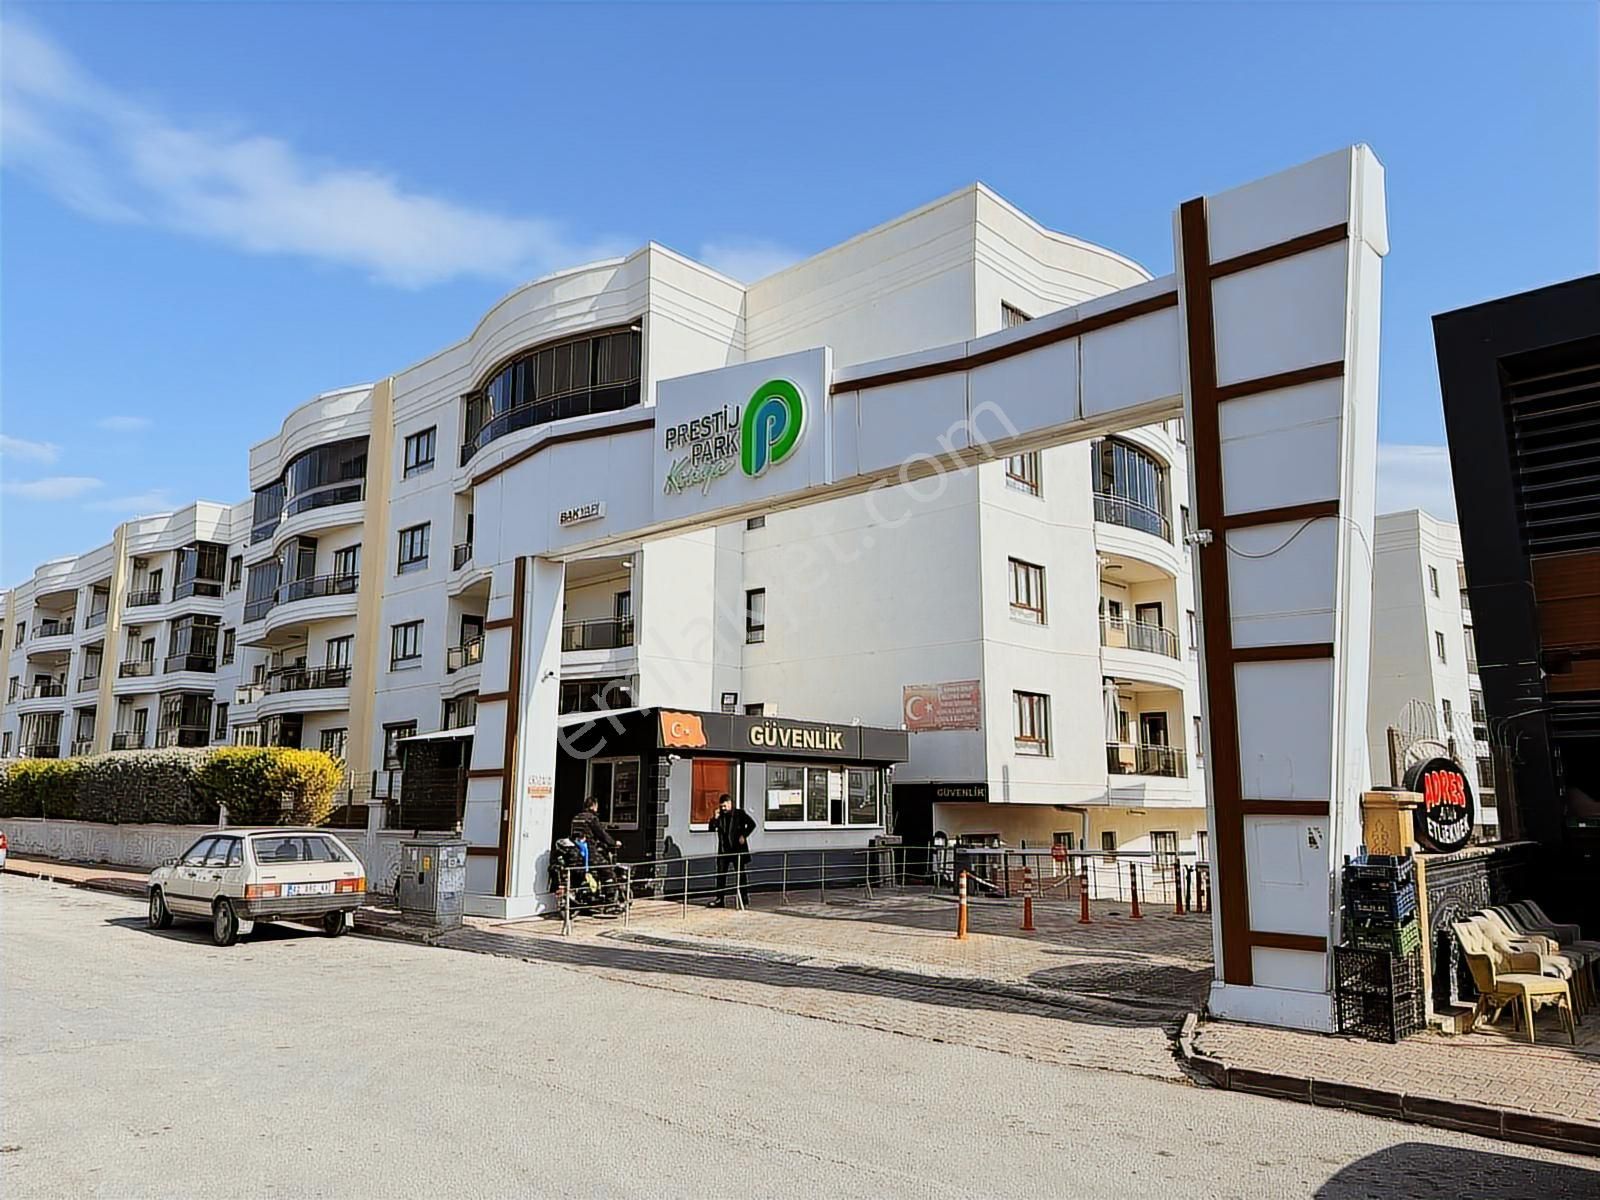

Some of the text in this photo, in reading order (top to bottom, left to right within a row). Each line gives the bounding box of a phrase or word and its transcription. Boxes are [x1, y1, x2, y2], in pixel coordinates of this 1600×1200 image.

[665, 404, 741, 451] PRESTİJ
[691, 433, 740, 468] PARK
[750, 721, 843, 750] GÜVENLİK
[1424, 769, 1466, 813] ADRES
